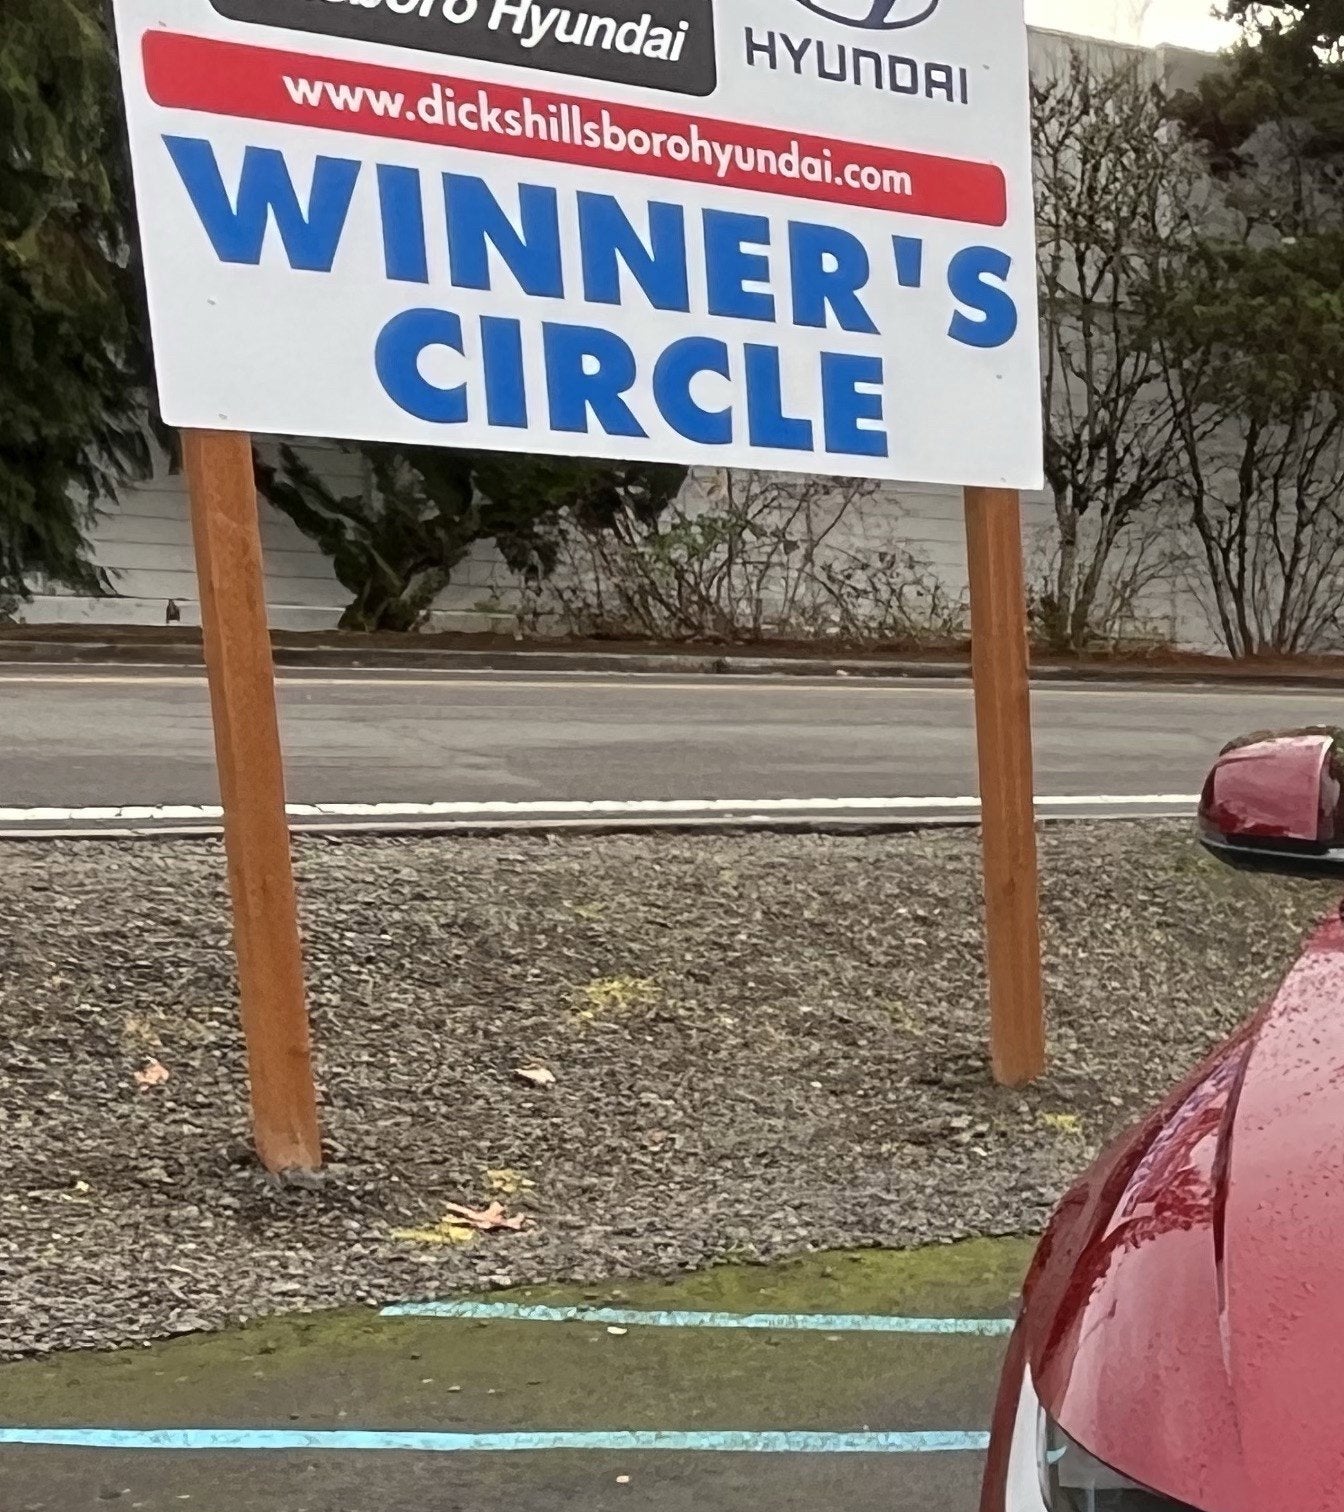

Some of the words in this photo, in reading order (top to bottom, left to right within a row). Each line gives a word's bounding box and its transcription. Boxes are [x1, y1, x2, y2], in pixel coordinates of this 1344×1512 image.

[487, 0, 690, 62] Hyundai
[744, 26, 968, 104] HYUNDAI
[281, 71, 914, 197] www.dickshillsborohyundai.com
[160, 134, 1018, 348] WINNER'S
[373, 307, 889, 459] CIRCLE
